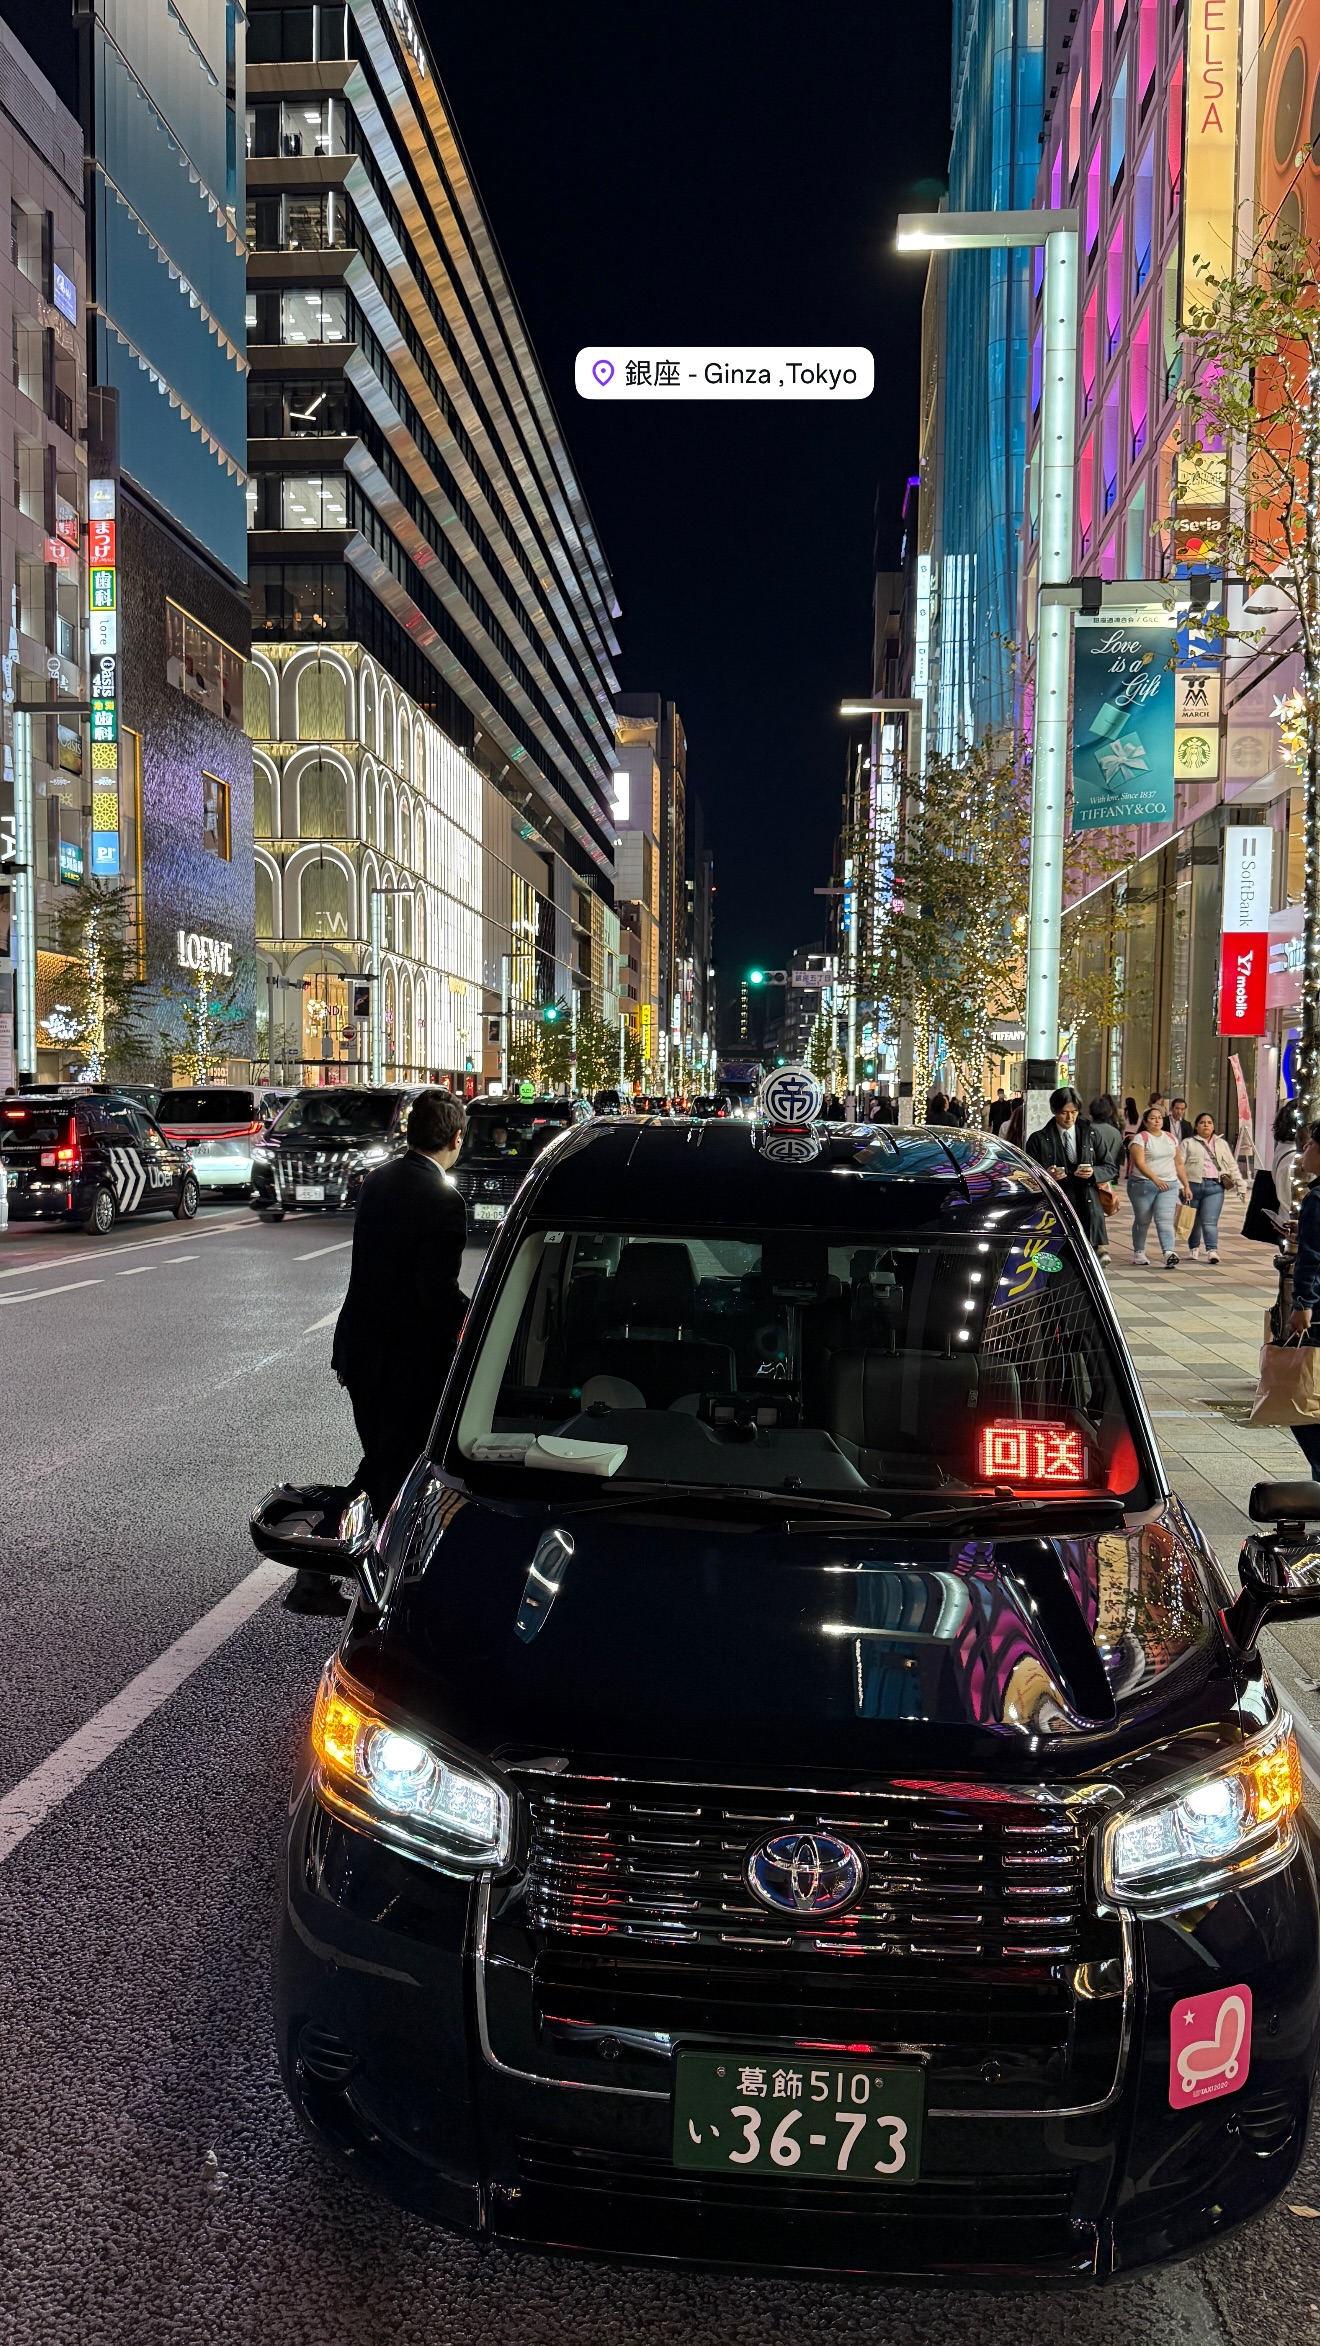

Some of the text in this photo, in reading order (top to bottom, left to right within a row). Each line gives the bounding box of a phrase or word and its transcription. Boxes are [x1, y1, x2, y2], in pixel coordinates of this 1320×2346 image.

[94, 521, 111, 558] まつげ
[1180, 516, 1222, 532] Seria
[95, 570, 113, 607] 歯科
[1090, 629, 1142, 654] Love
[100, 656, 116, 698] Oasis
[1107, 656, 1144, 673] is a
[1114, 672, 1162, 707] Gift
[1089, 795, 1106, 805] With
[1121, 792, 1139, 800] Since
[1139, 790, 1157, 799] 1837
[1239, 860, 1256, 928] SoftBank
[177, 930, 234, 977] LOEWE
[990, 1030, 1026, 1041] TIFFANY
[150, 1165, 174, 1189] Uber
[985, 1428, 1080, 1480] 回送
[688, 2105, 908, 2175] い 36-73
